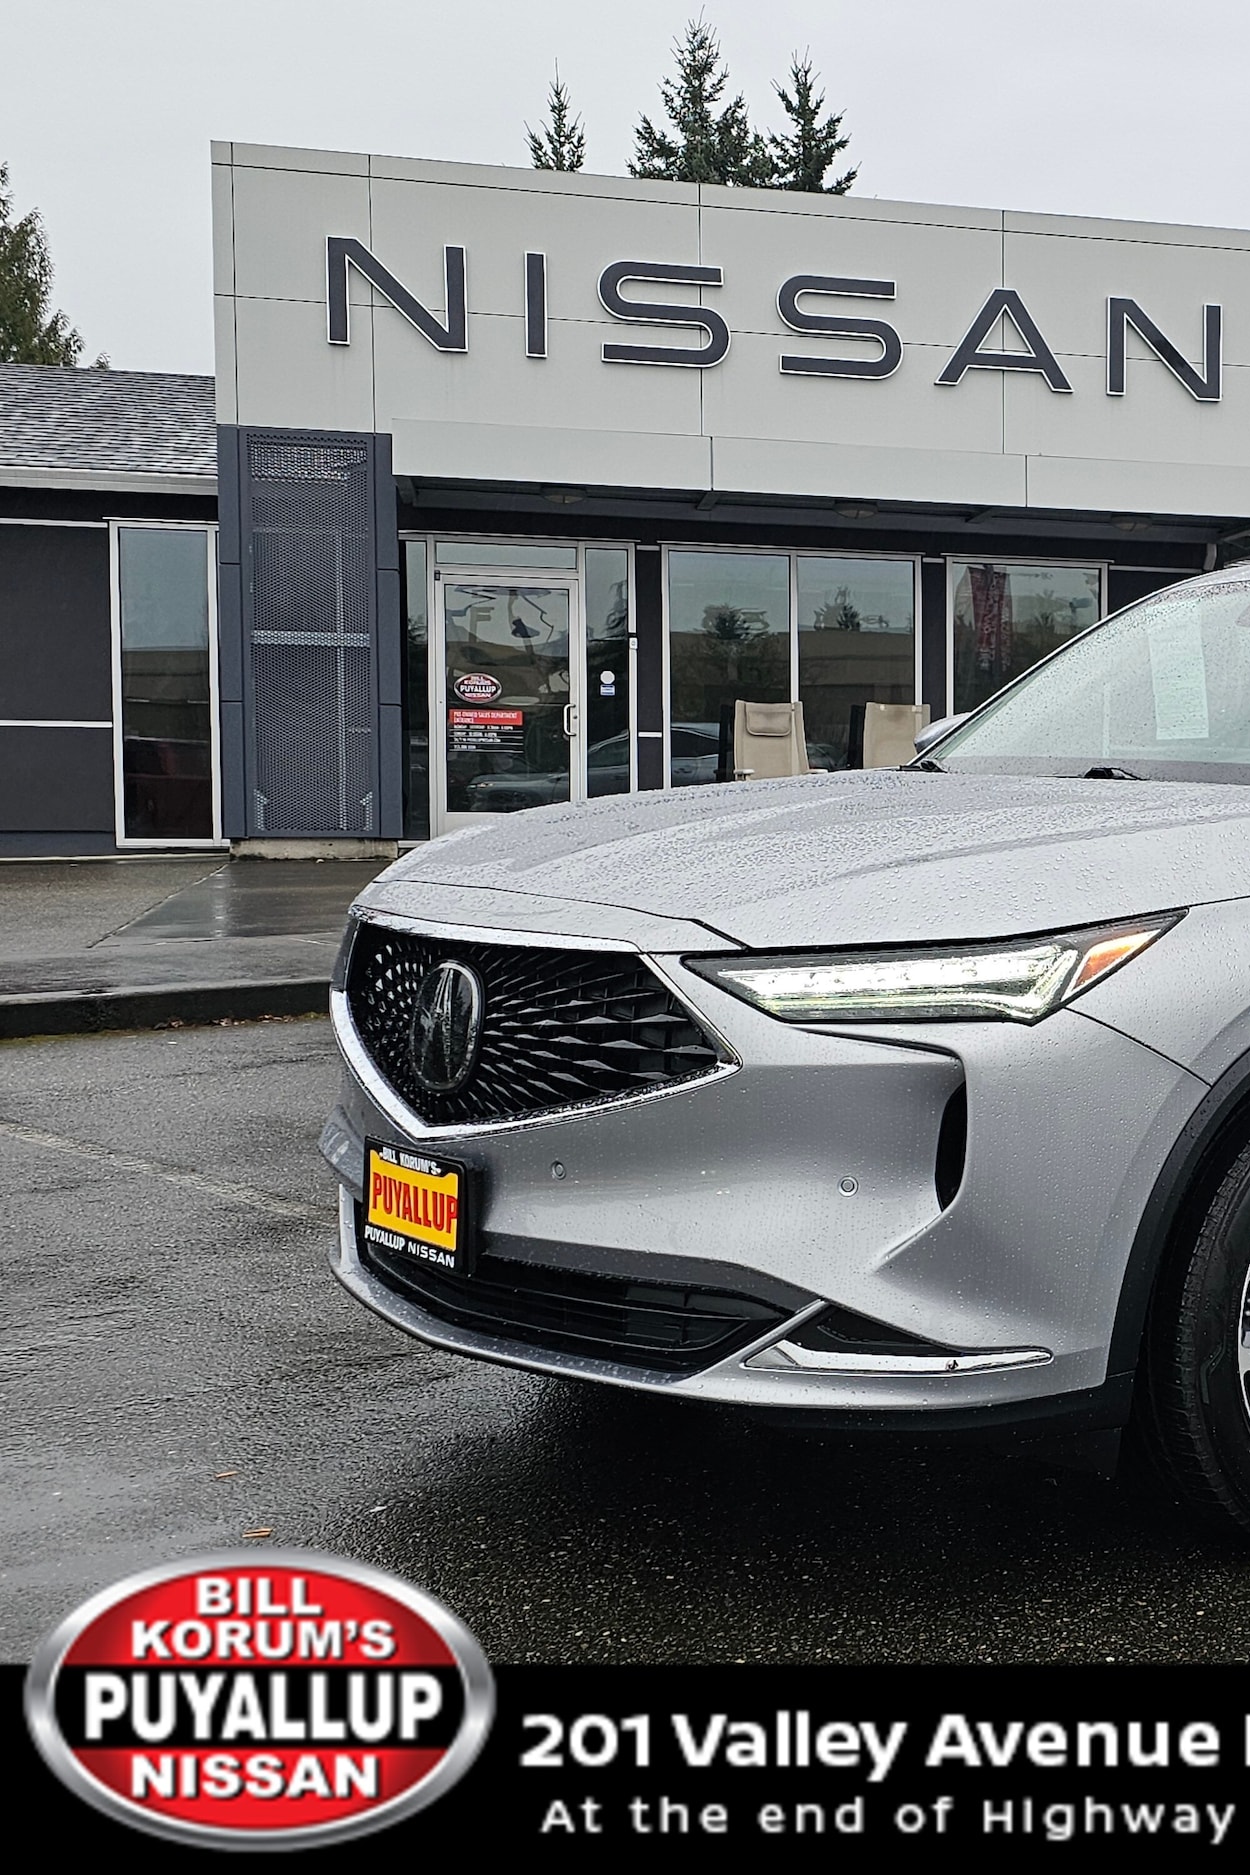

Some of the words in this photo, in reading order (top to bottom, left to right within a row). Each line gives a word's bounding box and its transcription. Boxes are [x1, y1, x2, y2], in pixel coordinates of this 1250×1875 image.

[325, 234, 1223, 402] NISSAN
[460, 685, 497, 693] PUYALLUP
[382, 1146, 398, 1164] BILL
[399, 1152, 438, 1176] KORUM'S
[372, 1171, 458, 1235] PUYALLUP
[364, 1224, 406, 1252] PUYALLUP
[407, 1240, 455, 1269] NISSAN
